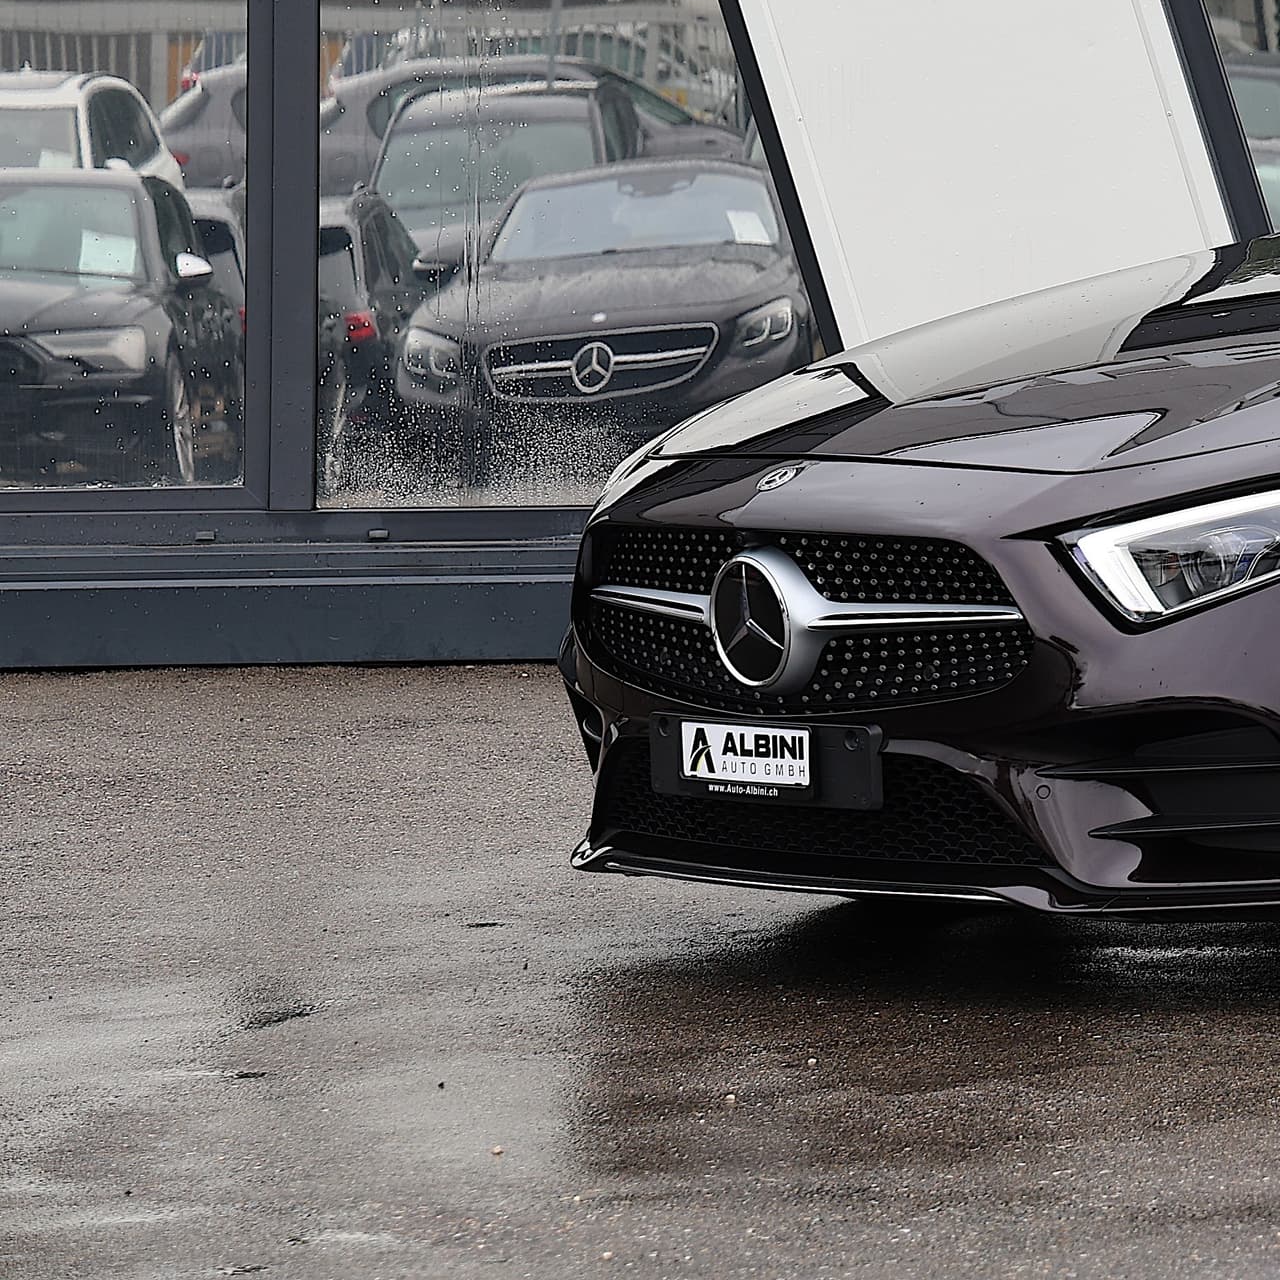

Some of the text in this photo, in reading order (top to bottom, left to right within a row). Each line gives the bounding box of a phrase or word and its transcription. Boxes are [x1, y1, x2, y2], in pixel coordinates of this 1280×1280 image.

[721, 731, 805, 761] ALBINI
[721, 760, 806, 777] AUTO GMBH
[709, 784, 778, 796] www.Auto-Albini.ch
